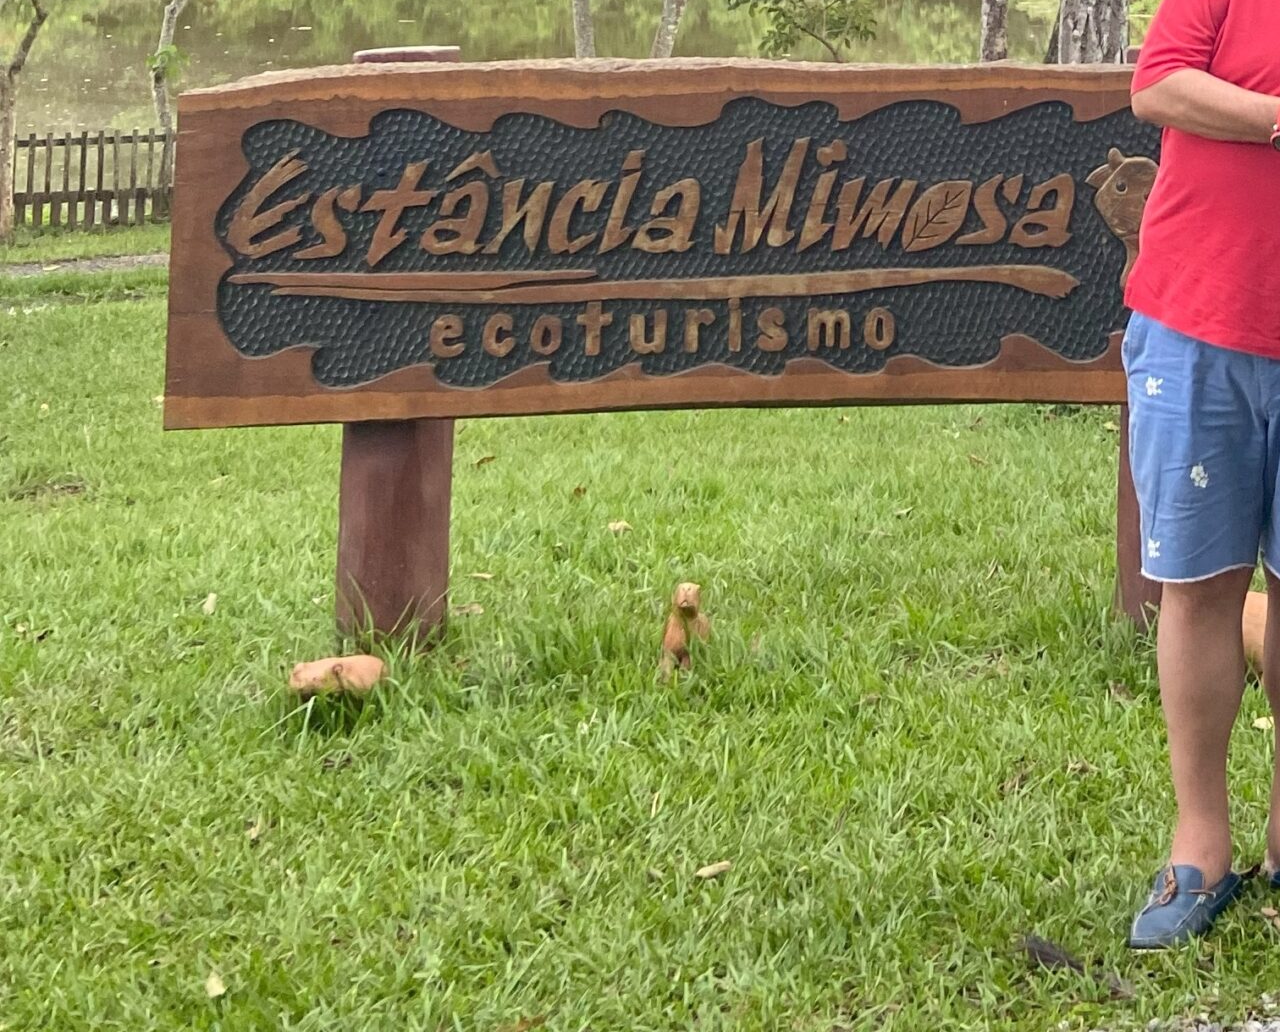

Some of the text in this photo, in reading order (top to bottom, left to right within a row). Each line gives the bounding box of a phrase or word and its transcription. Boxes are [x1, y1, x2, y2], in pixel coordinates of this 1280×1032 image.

[227, 136, 1075, 266] Estância Mimosa
[430, 297, 896, 357] ecoturismo
